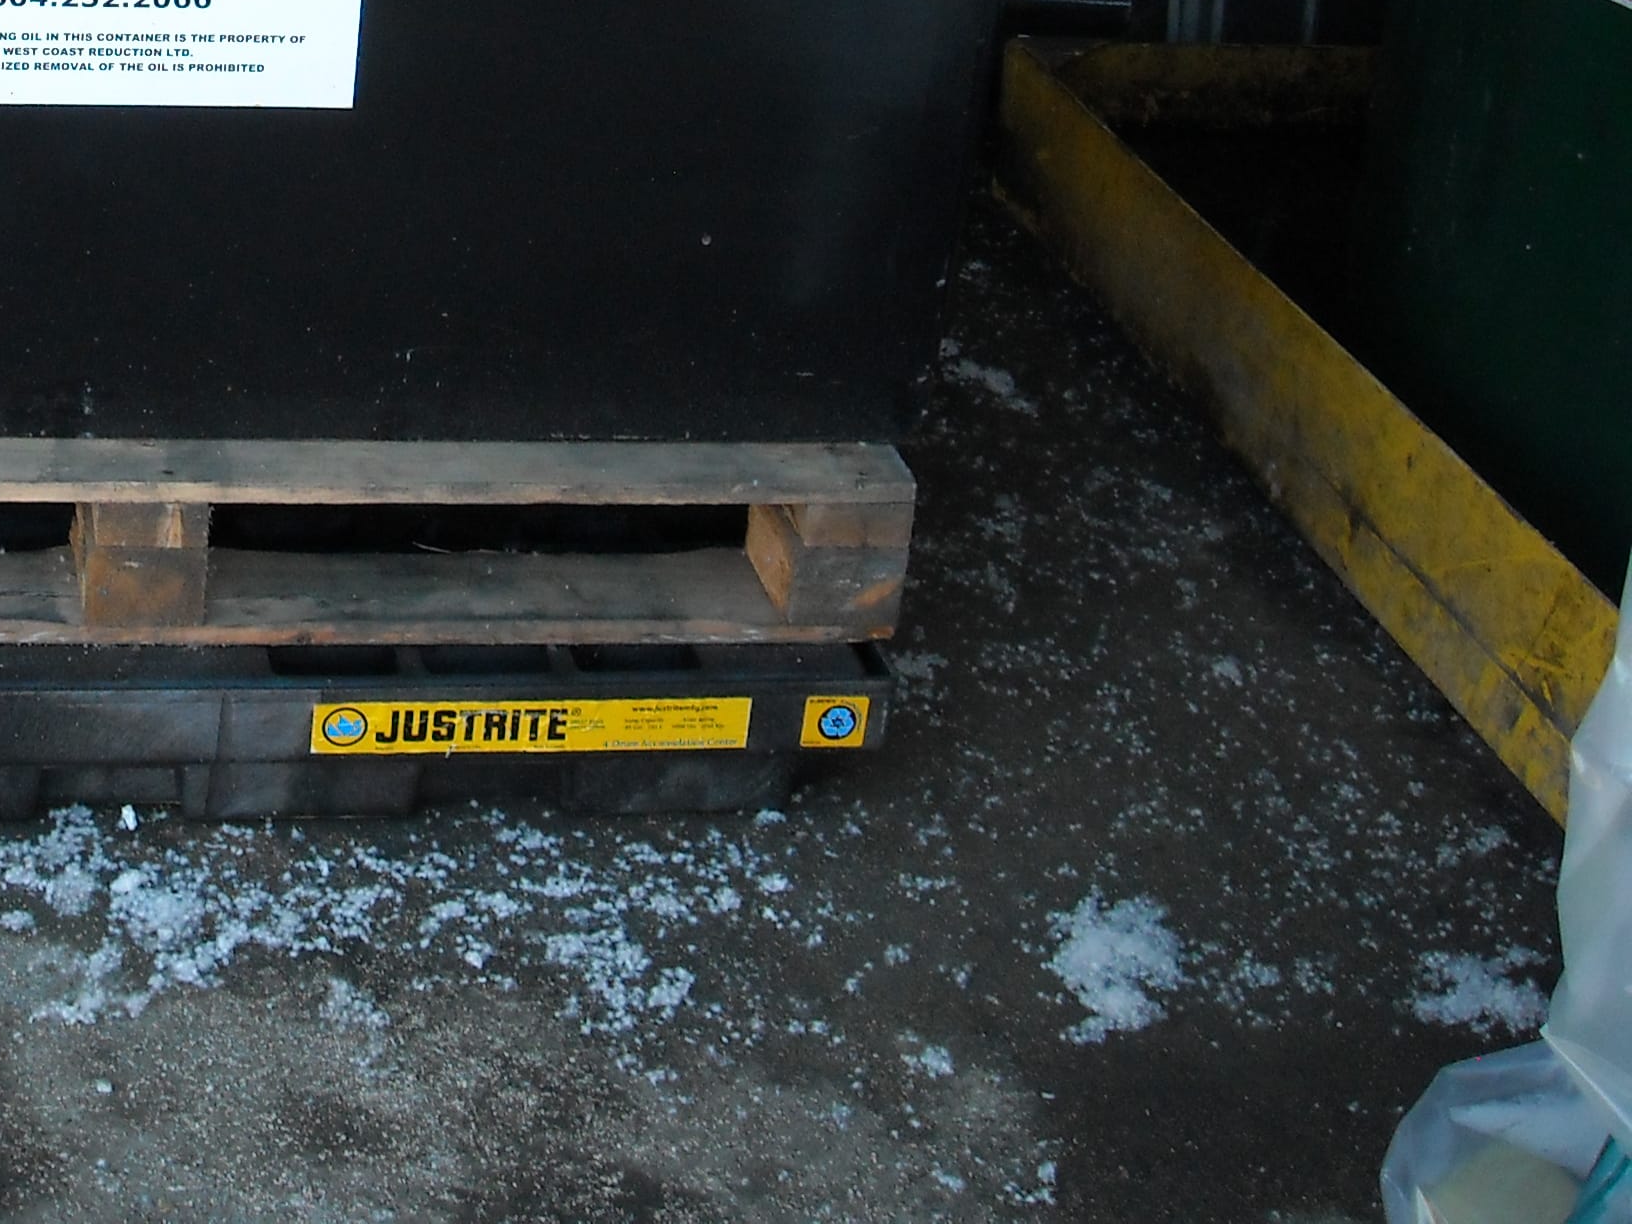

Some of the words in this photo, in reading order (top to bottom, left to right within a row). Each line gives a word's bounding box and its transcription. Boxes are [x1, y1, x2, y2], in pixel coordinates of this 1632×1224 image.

[21, 32, 42, 42] OIL
[45, 33, 59, 42] IN
[64, 33, 92, 43] THIS
[97, 33, 170, 44] CONTAINER
[174, 33, 186, 44] IS
[191, 33, 215, 44] THE
[220, 34, 285, 45] PROPERTY
[290, 34, 306, 45] OF
[3, 47, 39, 57] WEST
[43, 47, 84, 57] COAST
[88, 47, 162, 58] REDUCTION
[167, 48, 193, 58] LTD.
[34, 62, 95, 72] REMOVAL
[100, 62, 116, 72] OF
[119, 62, 144, 73] THE
[147, 63, 168, 73] OIL
[172, 63, 184, 73] IS
[188, 63, 265, 74] PROHIBITED
[376, 709, 568, 743] JUSTRITE
